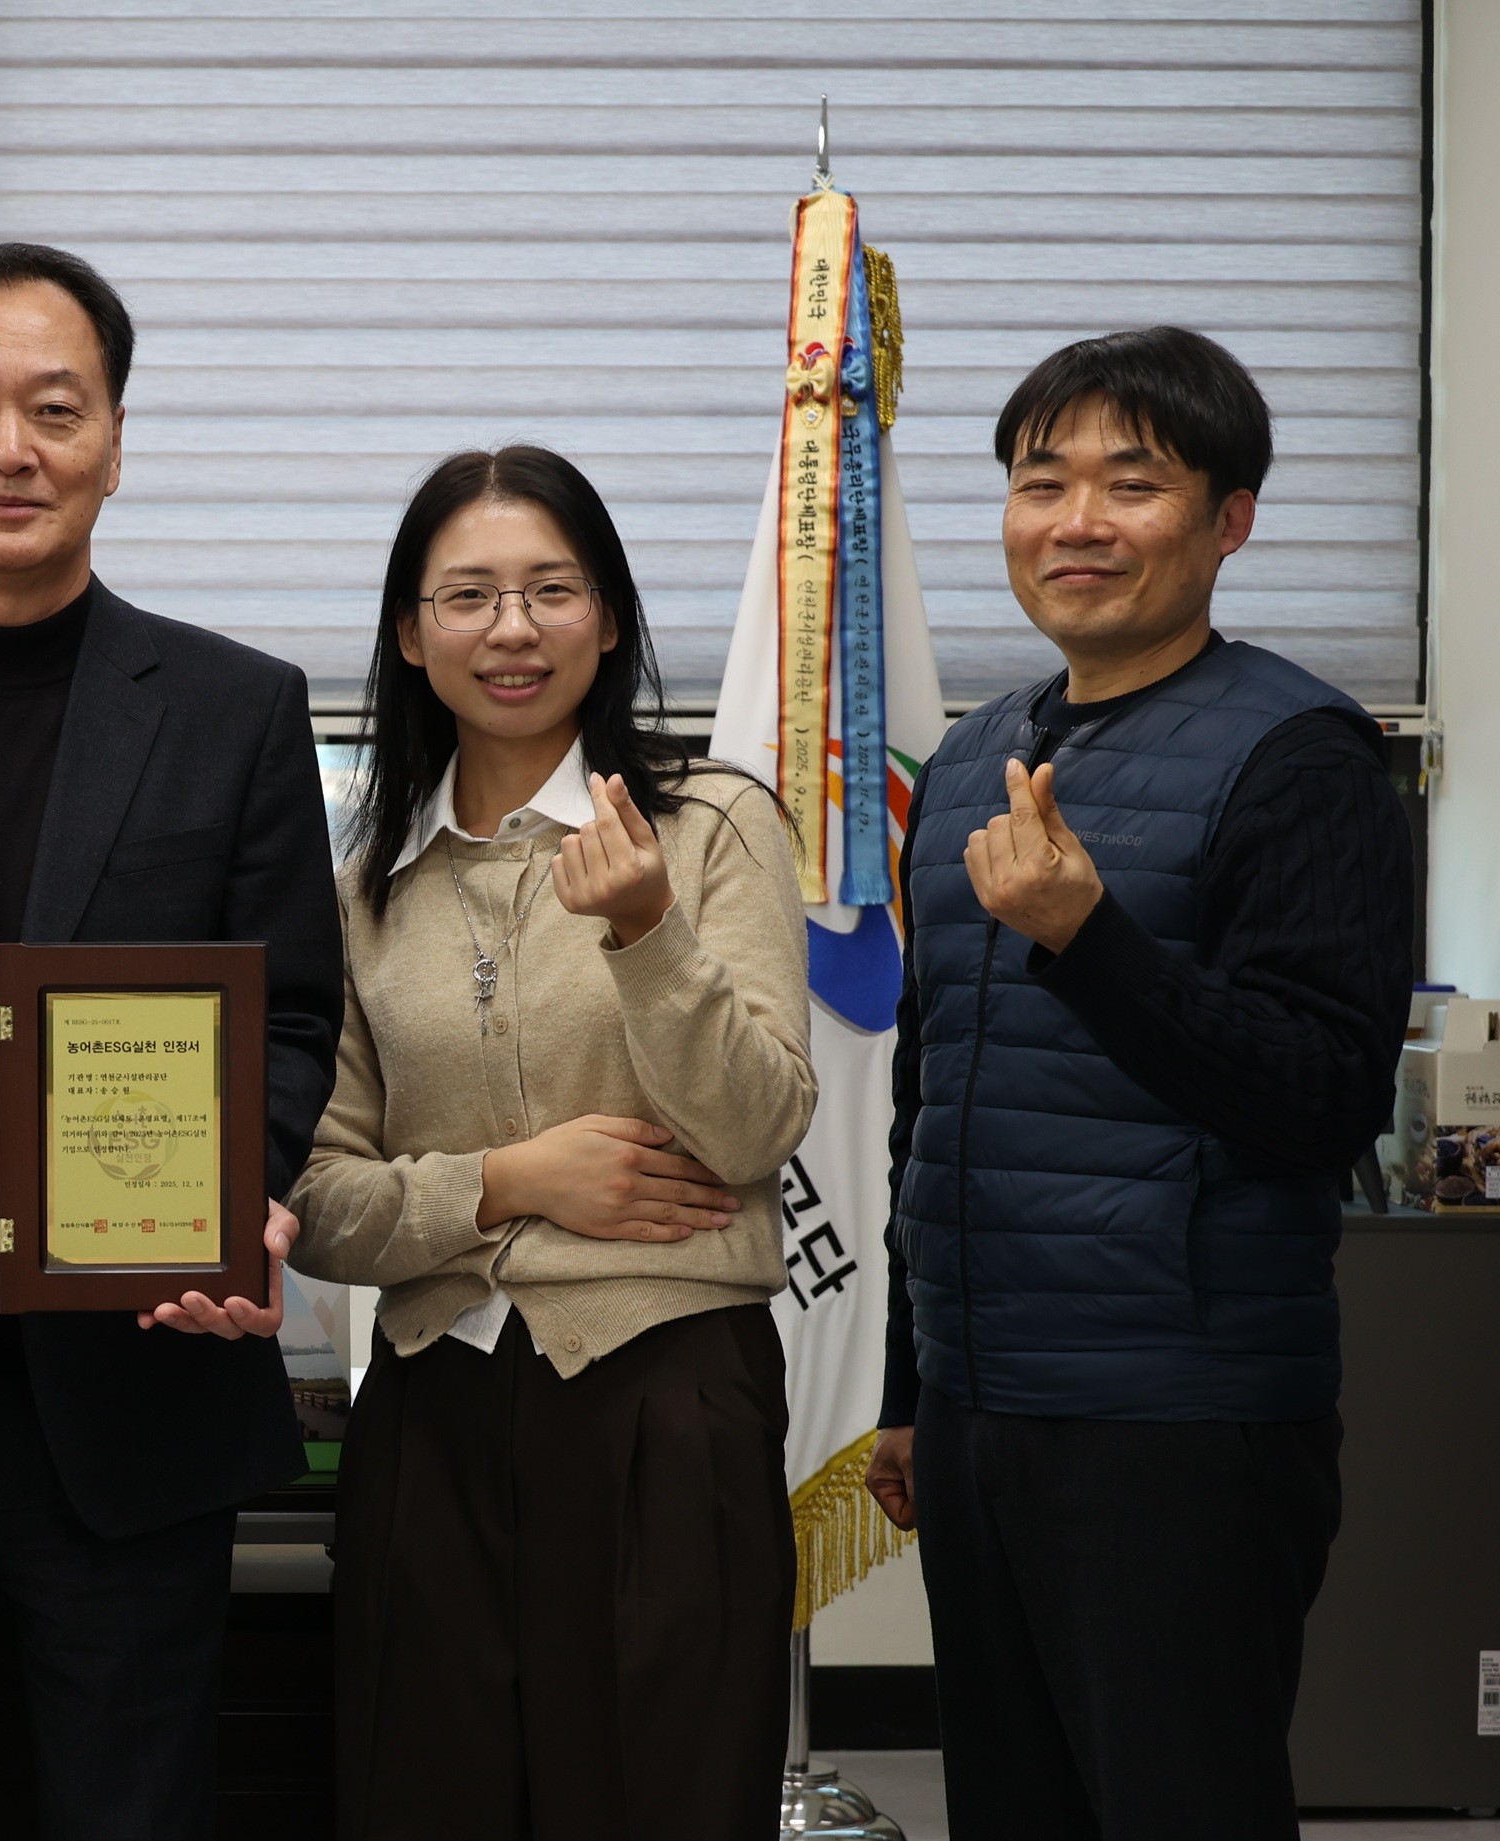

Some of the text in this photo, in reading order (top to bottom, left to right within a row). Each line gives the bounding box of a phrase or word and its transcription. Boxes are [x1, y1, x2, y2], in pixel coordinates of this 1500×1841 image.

[807, 259, 830, 319] 대한민국
[67, 1040, 200, 1054] 농어촌ESG실천 인정서
[100, 1073, 167, 1082] 연천군시설관리공단
